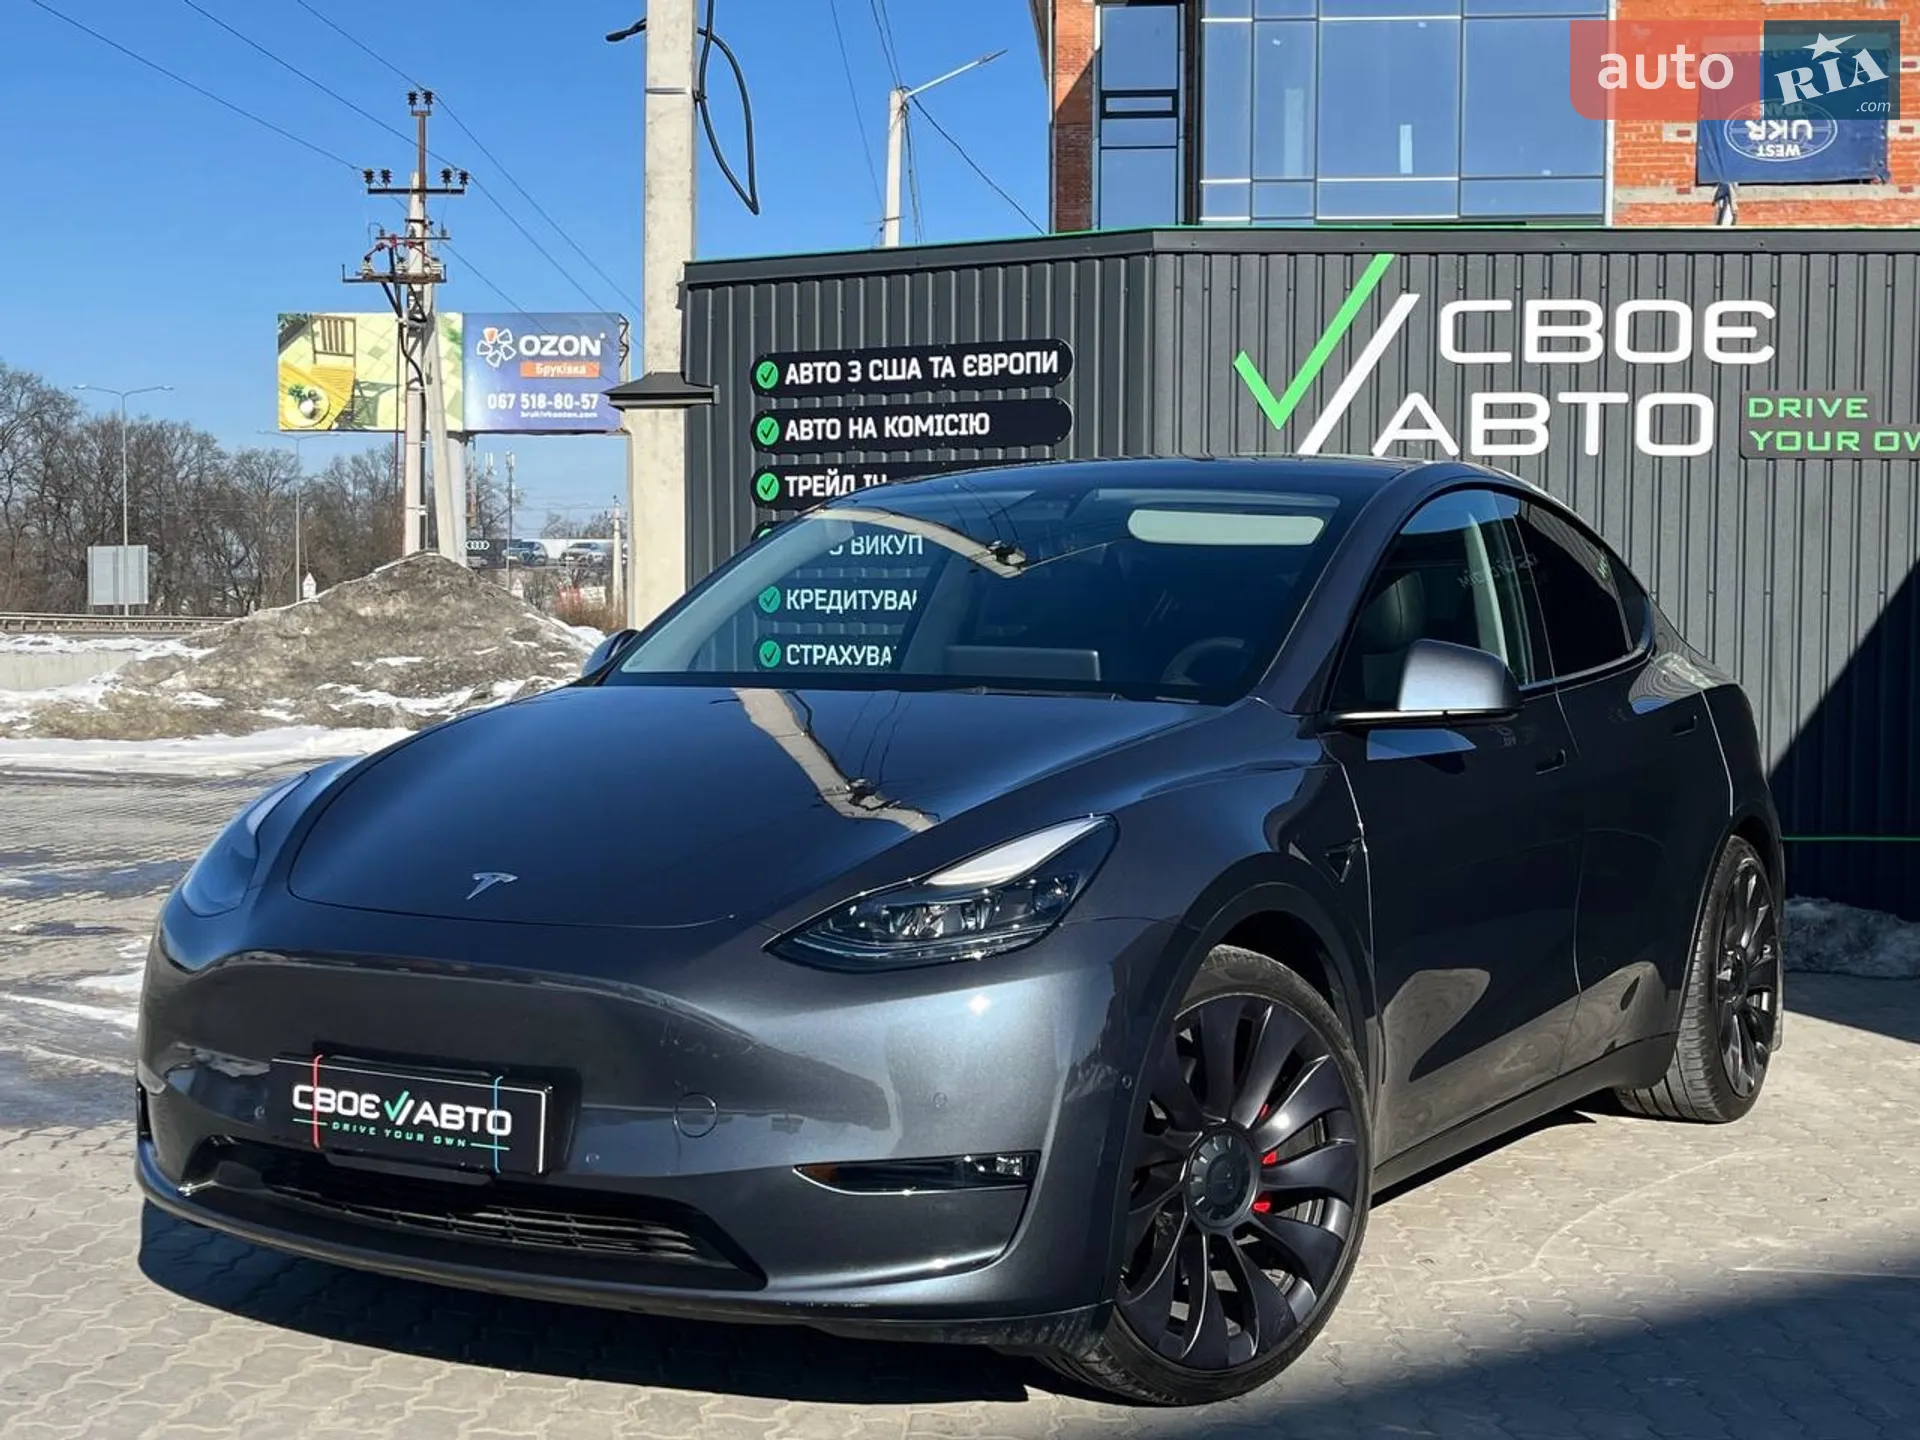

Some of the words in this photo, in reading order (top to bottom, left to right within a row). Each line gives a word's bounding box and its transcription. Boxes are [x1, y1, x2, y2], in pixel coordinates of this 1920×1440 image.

[1745, 119, 1813, 140] UKR
[1756, 143, 1801, 157] WEST
[1440, 300, 1776, 364] СВОЄ
[519, 335, 601, 356] OZON
[535, 362, 586, 377] Бруківка
[784, 361, 842, 386] АВТО
[847, 360, 862, 383] З
[868, 356, 923, 381] США
[928, 355, 957, 379] ТА
[962, 350, 1059, 377] ЄВРОПИ
[487, 393, 516, 410] 067
[520, 393, 599, 410] 518-80-57
[1749, 397, 1869, 418] DRIVE
[784, 417, 842, 442] АВТО
[848, 416, 878, 439] НА
[884, 412, 990, 438] КОМІСІЮ
[1372, 392, 1714, 456] АВТО
[1749, 431, 1860, 451] YOUR
[784, 468, 855, 497] ТРЕЙД
[851, 534, 923, 555] ВИКУП
[786, 645, 897, 666] СТРАХУВА
[293, 1085, 380, 1119] СВОЄ
[412, 1100, 512, 1136] АВТО
[331, 1121, 377, 1136] DRIVE
[384, 1128, 425, 1142] YOUR
[433, 1135, 467, 1148] OWN
